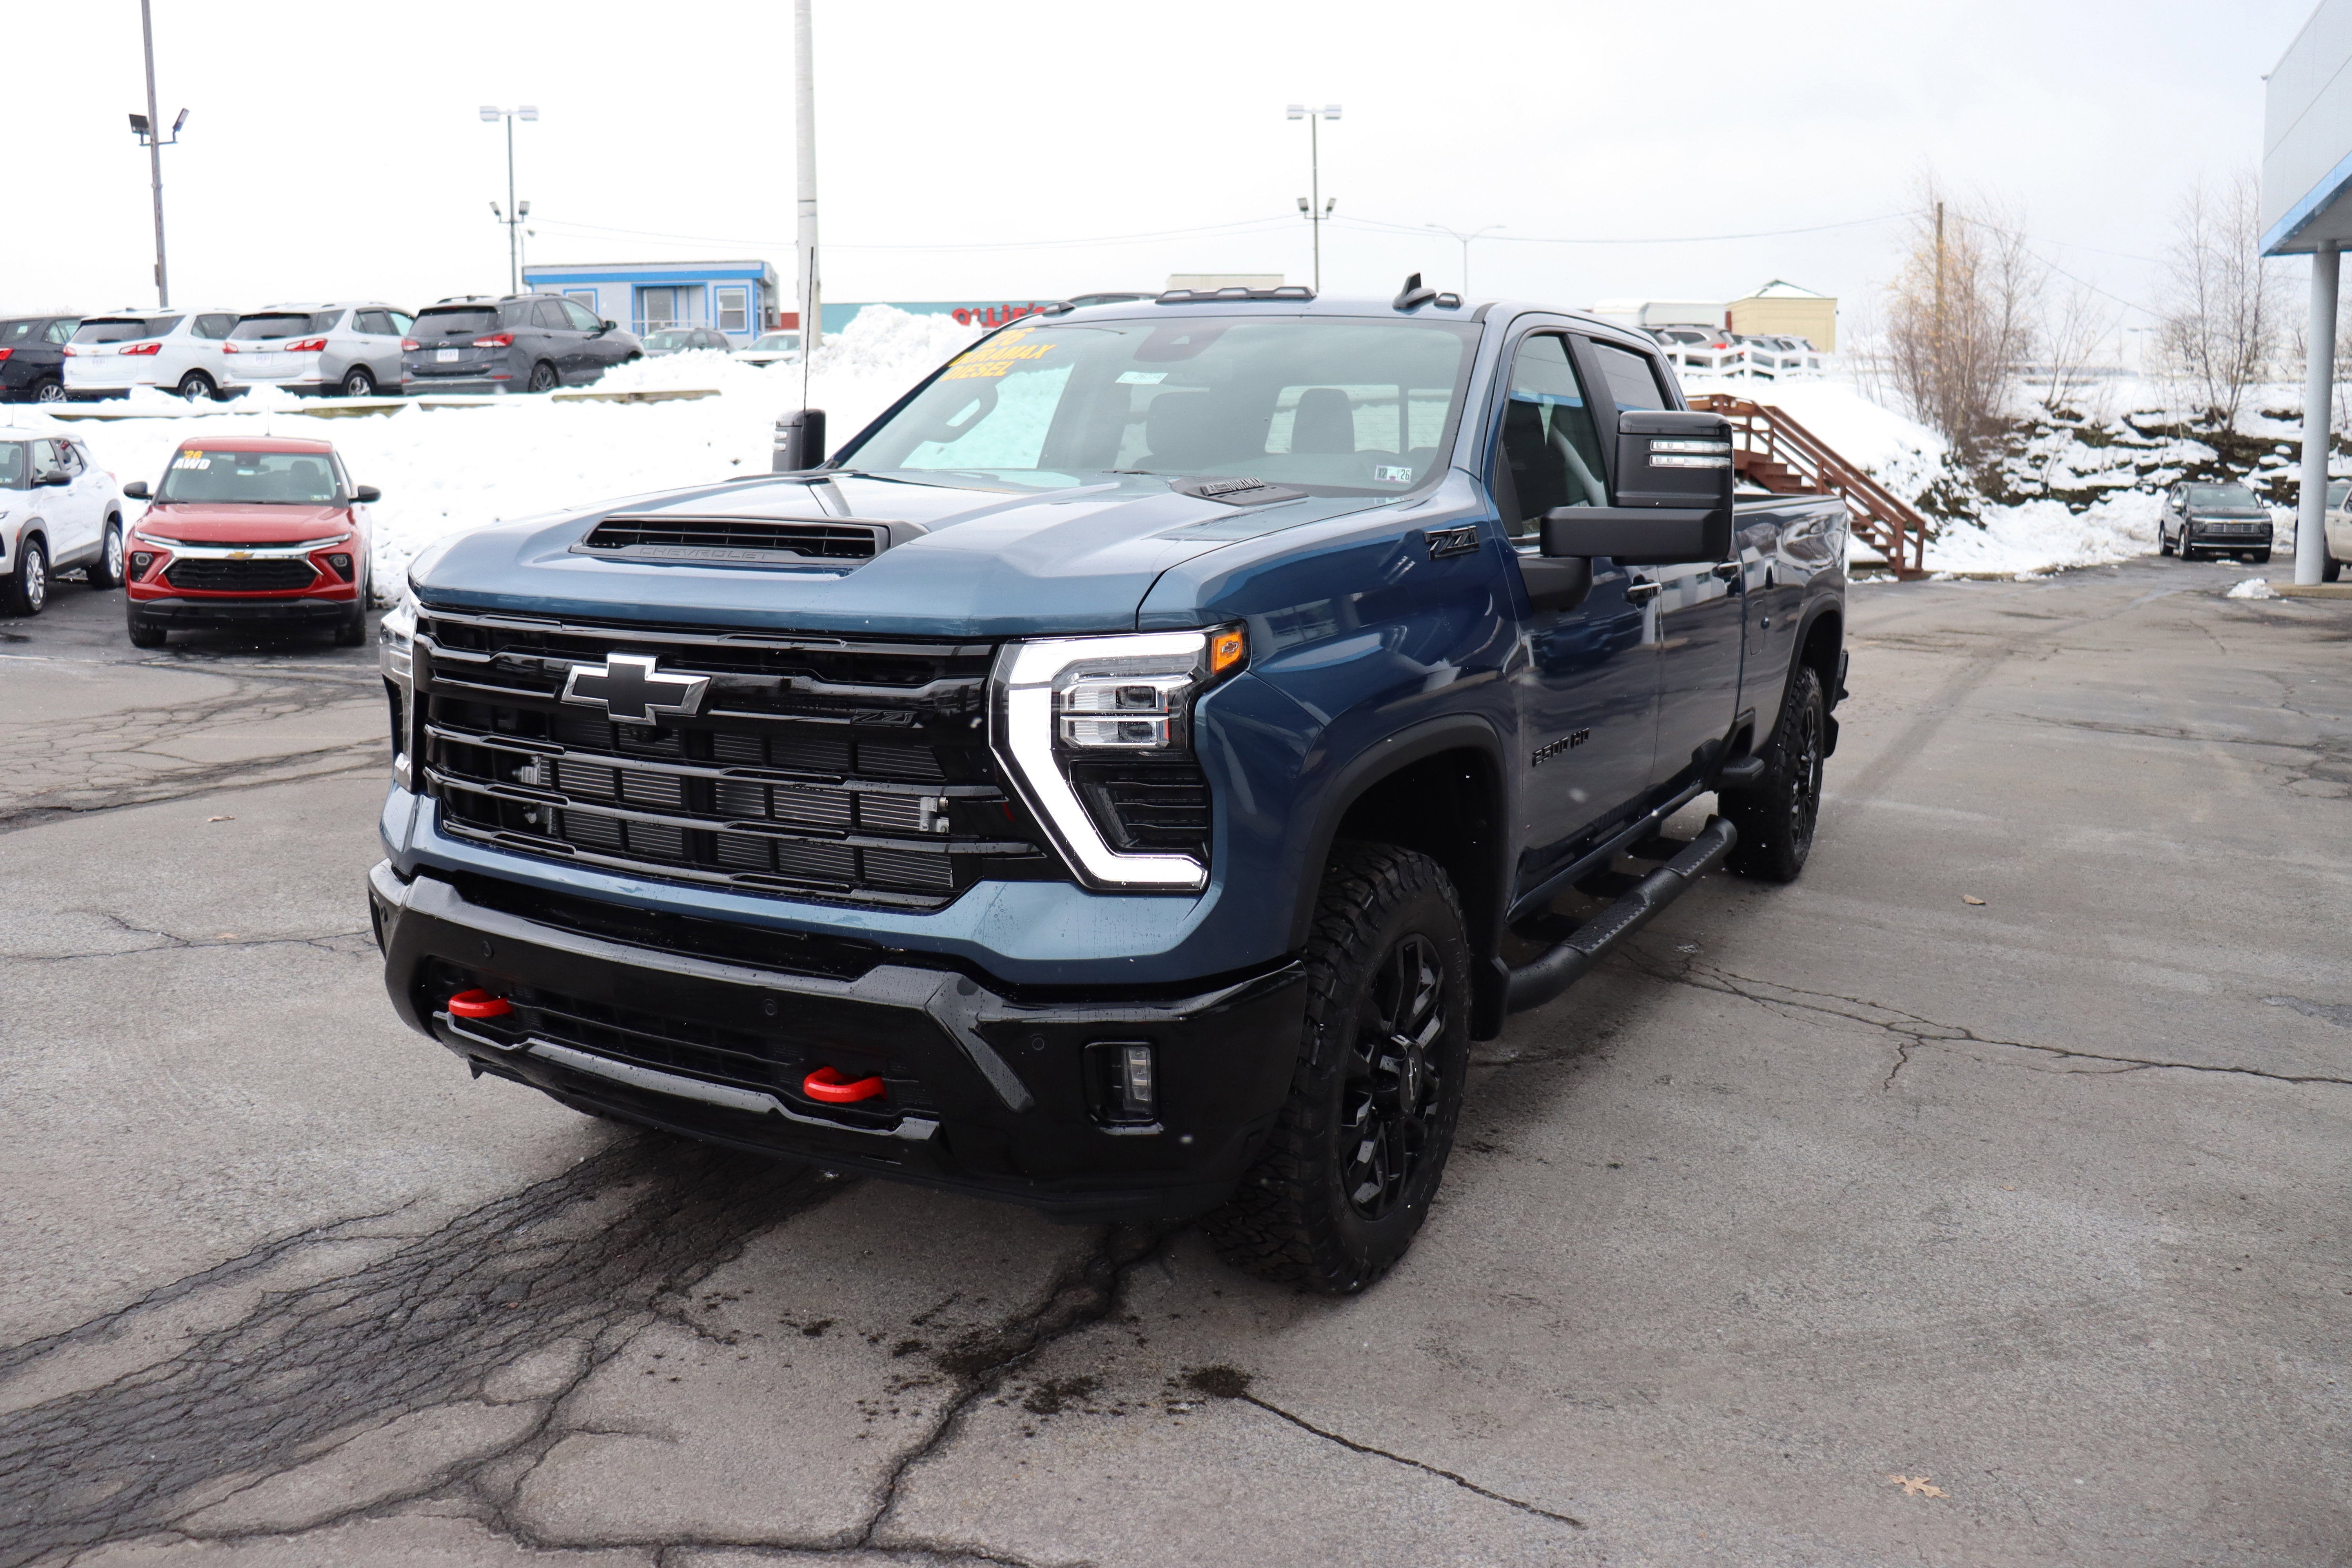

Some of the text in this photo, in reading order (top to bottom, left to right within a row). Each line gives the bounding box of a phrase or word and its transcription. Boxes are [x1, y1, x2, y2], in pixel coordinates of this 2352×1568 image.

[948, 344, 1057, 367] DURAMAX
[939, 361, 1015, 381] DIESEL
[172, 458, 211, 470] AWD
[1378, 468, 1410, 480] 12 26
[1226, 477, 1265, 491] DURAMAX
[1423, 525, 1480, 560] Z71
[639, 547, 774, 559] CHEVROLET
[851, 708, 917, 728] Z71
[1532, 727, 1590, 768] 2500 HD
